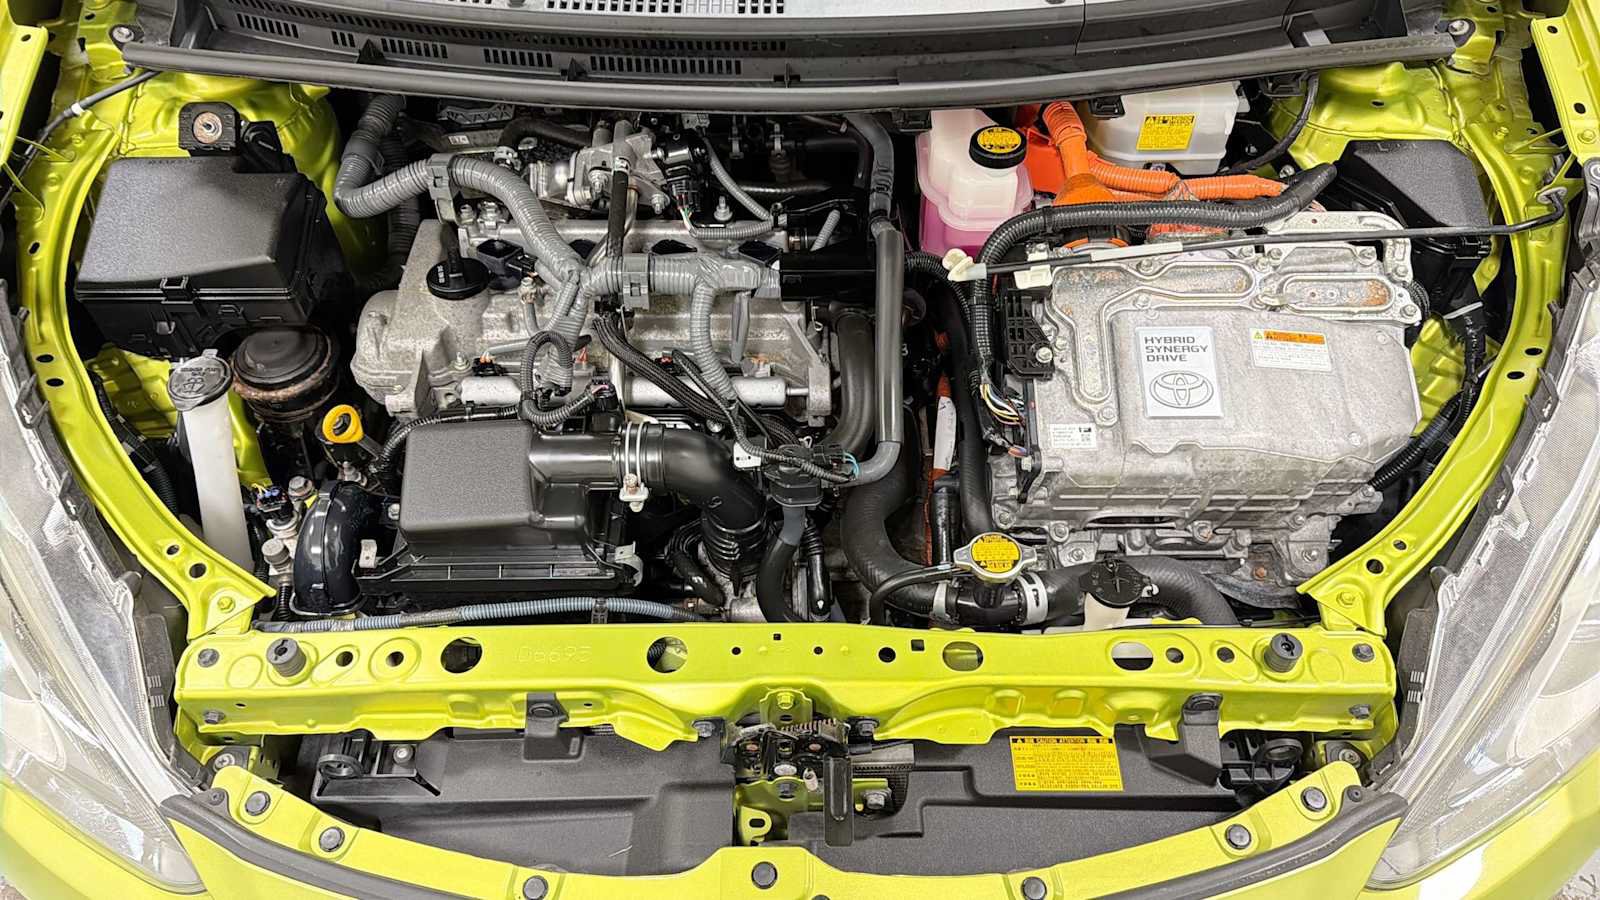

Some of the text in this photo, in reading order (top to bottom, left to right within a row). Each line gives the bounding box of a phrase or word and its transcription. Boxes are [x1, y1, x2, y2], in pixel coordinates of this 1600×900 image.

[1144, 336, 1195, 344] HYBRID
[1145, 345, 1208, 353] SYNERGY
[1146, 354, 1188, 362] DRIVE
